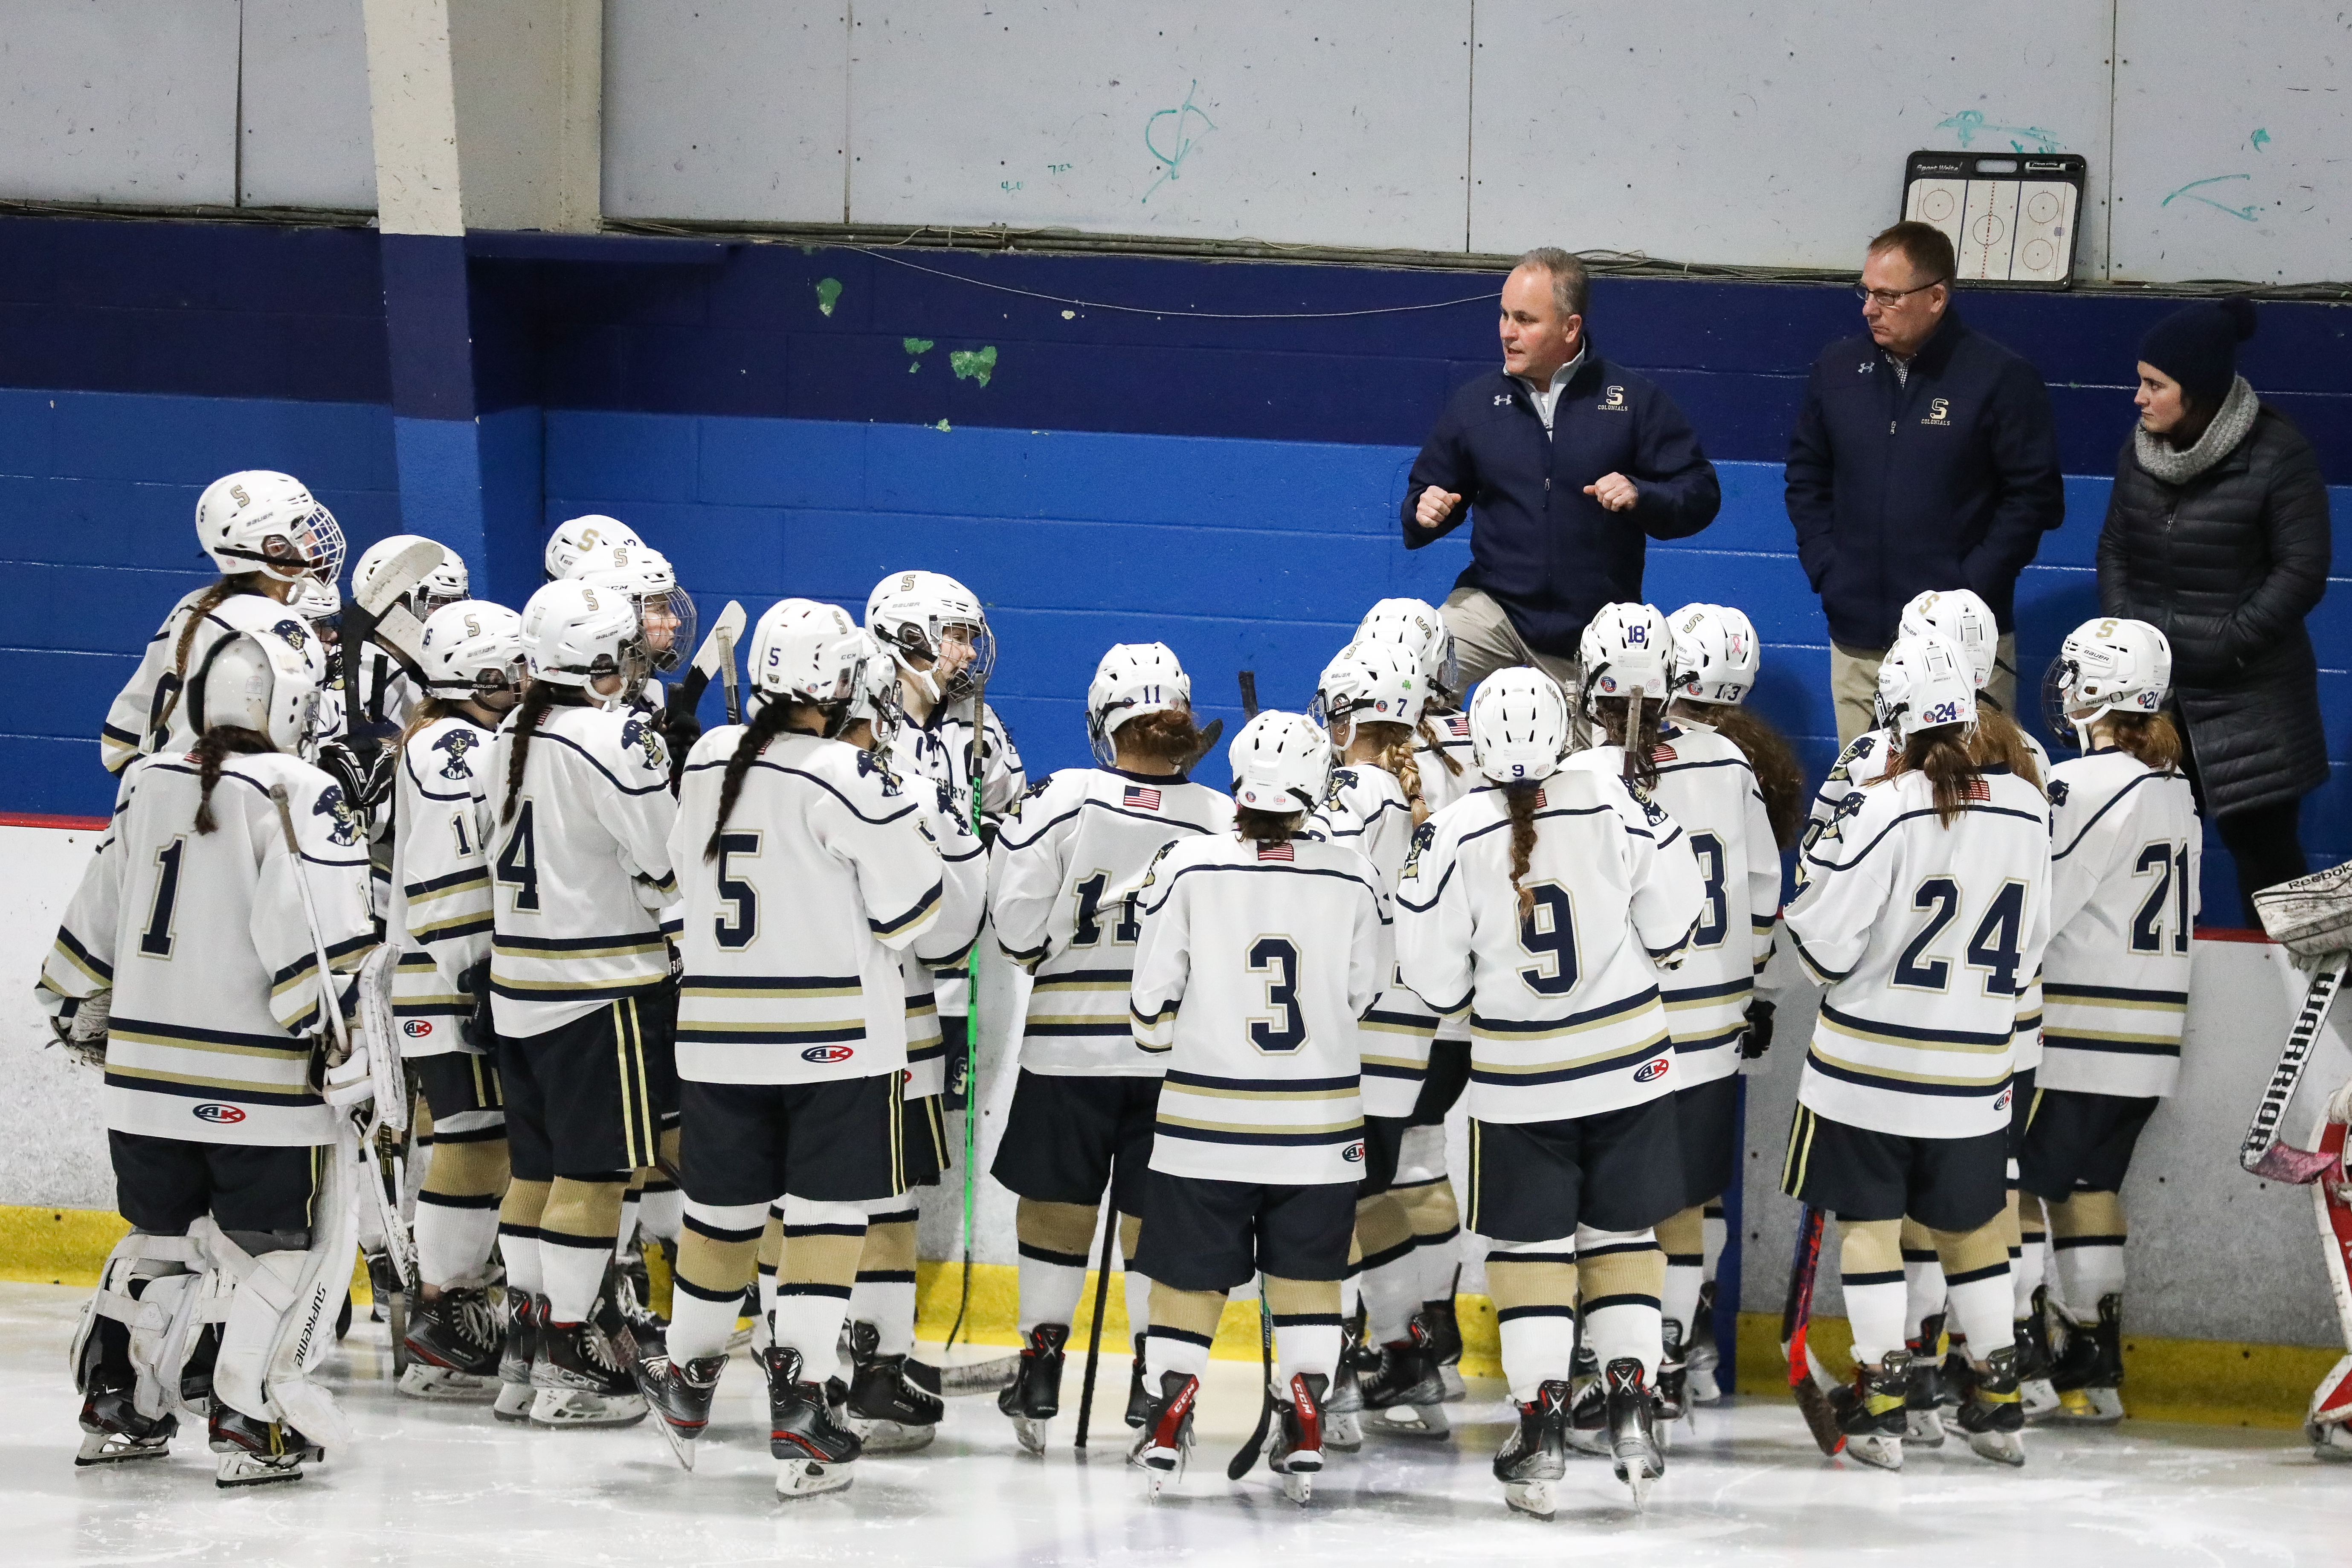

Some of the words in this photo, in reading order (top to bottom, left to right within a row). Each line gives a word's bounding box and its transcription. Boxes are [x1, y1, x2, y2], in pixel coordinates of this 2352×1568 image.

[1606, 385, 1624, 405] S
[1930, 398, 1949, 420] S
[229, 484, 250, 508] S
[577, 529, 599, 551] S
[613, 548, 628, 567] S
[901, 574, 916, 591] S
[582, 589, 599, 611] S
[1919, 594, 1940, 615] S
[464, 614, 481, 637] S
[832, 611, 847, 635] S
[1415, 616, 1432, 640] S
[1627, 625, 1645, 643] 18
[1682, 613, 1704, 634] S
[1902, 623, 1917, 637] BAUER
[2095, 620, 2119, 640] S
[595, 630, 618, 640] BAUER
[891, 638, 914, 650] BAUER
[768, 646, 781, 667] 5
[2083, 649, 2110, 661] BAUER
[1143, 684, 1160, 704] 11
[1714, 684, 1741, 701] 13
[2085, 696, 2109, 706] BAUER
[2143, 691, 2159, 710] 21
[1396, 698, 1407, 717] 7
[1934, 701, 1957, 723] 24
[1512, 764, 1525, 777] 9
[973, 777, 981, 819] CCM
[494, 795, 542, 915] 4
[2288, 864, 2352, 890] Reebok
[136, 834, 187, 962] 1
[713, 828, 763, 953] 5
[2128, 838, 2188, 957] 21
[1515, 878, 1583, 1000] 9
[1888, 874, 2030, 1000] 24
[1244, 933, 1311, 1057] 3
[294, 1281, 326, 1369] SUPREME
[1294, 1383, 1312, 1414] CCM
